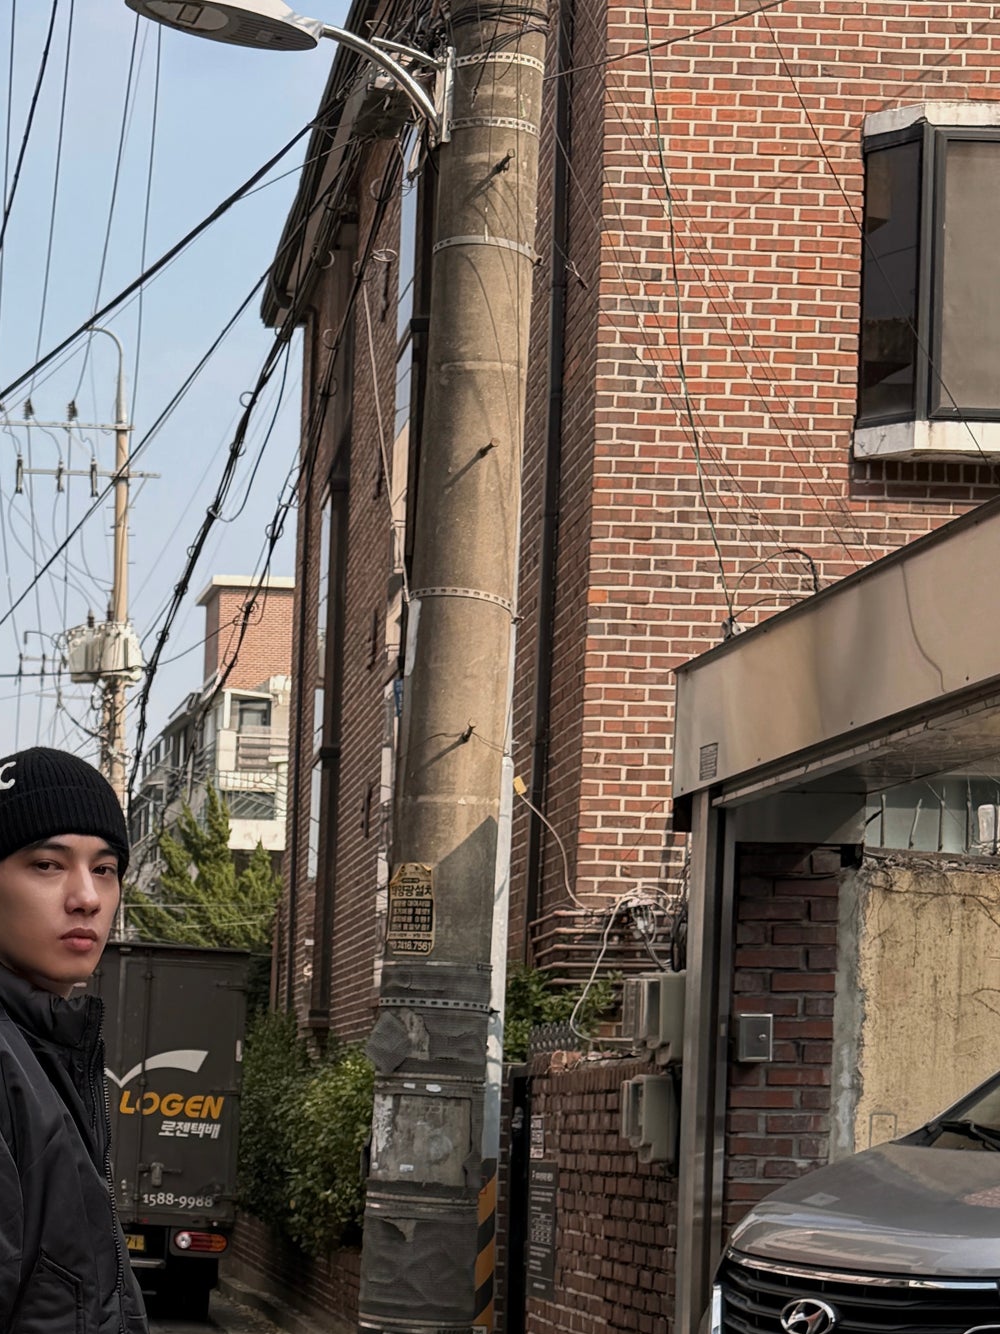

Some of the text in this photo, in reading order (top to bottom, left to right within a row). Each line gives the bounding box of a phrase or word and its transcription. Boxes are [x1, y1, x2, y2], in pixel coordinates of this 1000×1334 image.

[119, 1090, 225, 1120] LOGEN
[158, 1120, 221, 1140] 로젠택배
[142, 1191, 214, 1209] 1588-9988
